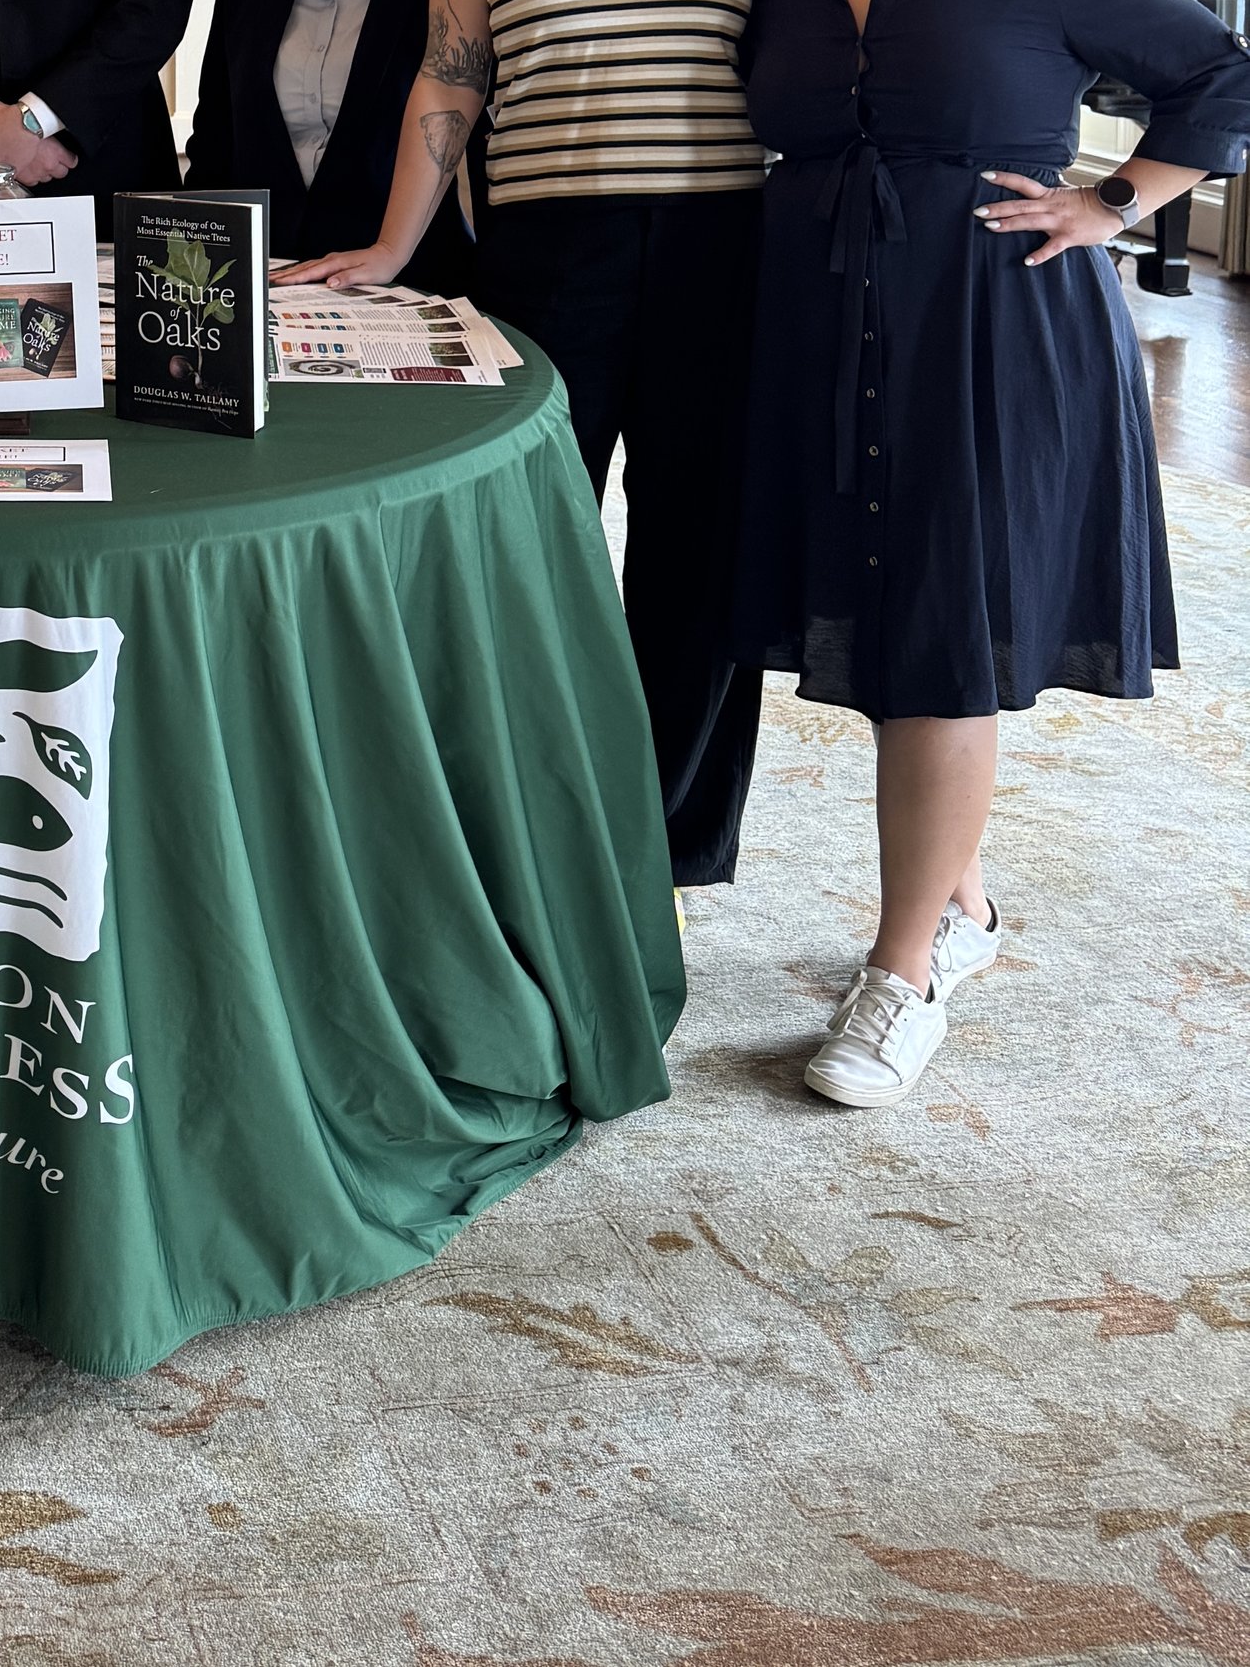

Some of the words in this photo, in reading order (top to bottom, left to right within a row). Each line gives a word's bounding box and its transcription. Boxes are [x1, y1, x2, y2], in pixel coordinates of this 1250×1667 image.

[141, 216, 155, 224] The
[156, 217, 171, 226] Rich
[172, 219, 199, 230] Ecology
[200, 221, 209, 229] of
[210, 222, 225, 231] Our
[137, 226, 154, 235] Most
[156, 229, 185, 238] Essential
[186, 231, 210, 241] Native
[211, 233, 230, 242] Trees
[137, 255, 154, 267] The
[135, 272, 235, 308] Nature
[170, 306, 182, 321] of
[138, 310, 221, 351] Oaks
[134, 386, 178, 399] DOUGLAS
[181, 392, 192, 401] W.
[195, 394, 240, 407] TALLAMY
